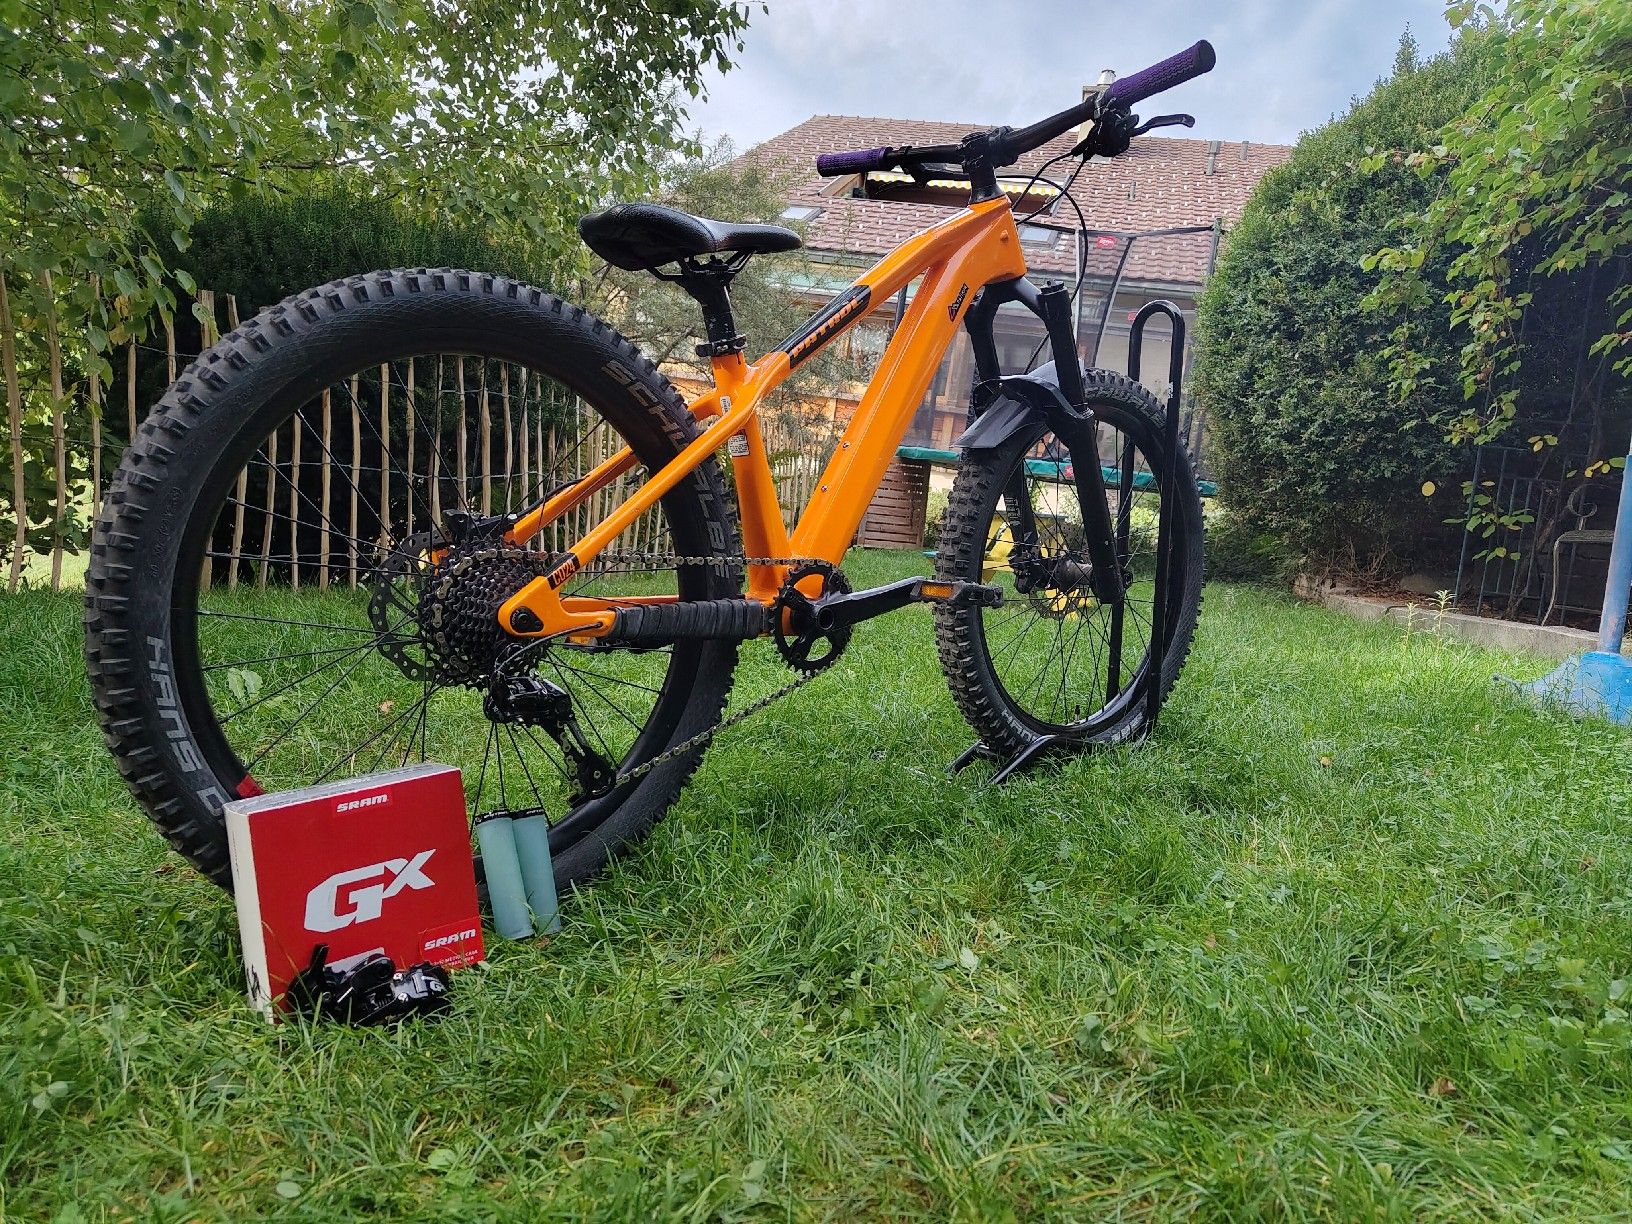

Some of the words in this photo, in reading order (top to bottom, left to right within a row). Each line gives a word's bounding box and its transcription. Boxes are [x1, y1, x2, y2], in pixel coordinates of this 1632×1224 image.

[147, 635, 202, 773] HANS
[336, 794, 388, 813] SRAM
[304, 849, 437, 933] GX
[424, 928, 476, 951] SRAM
